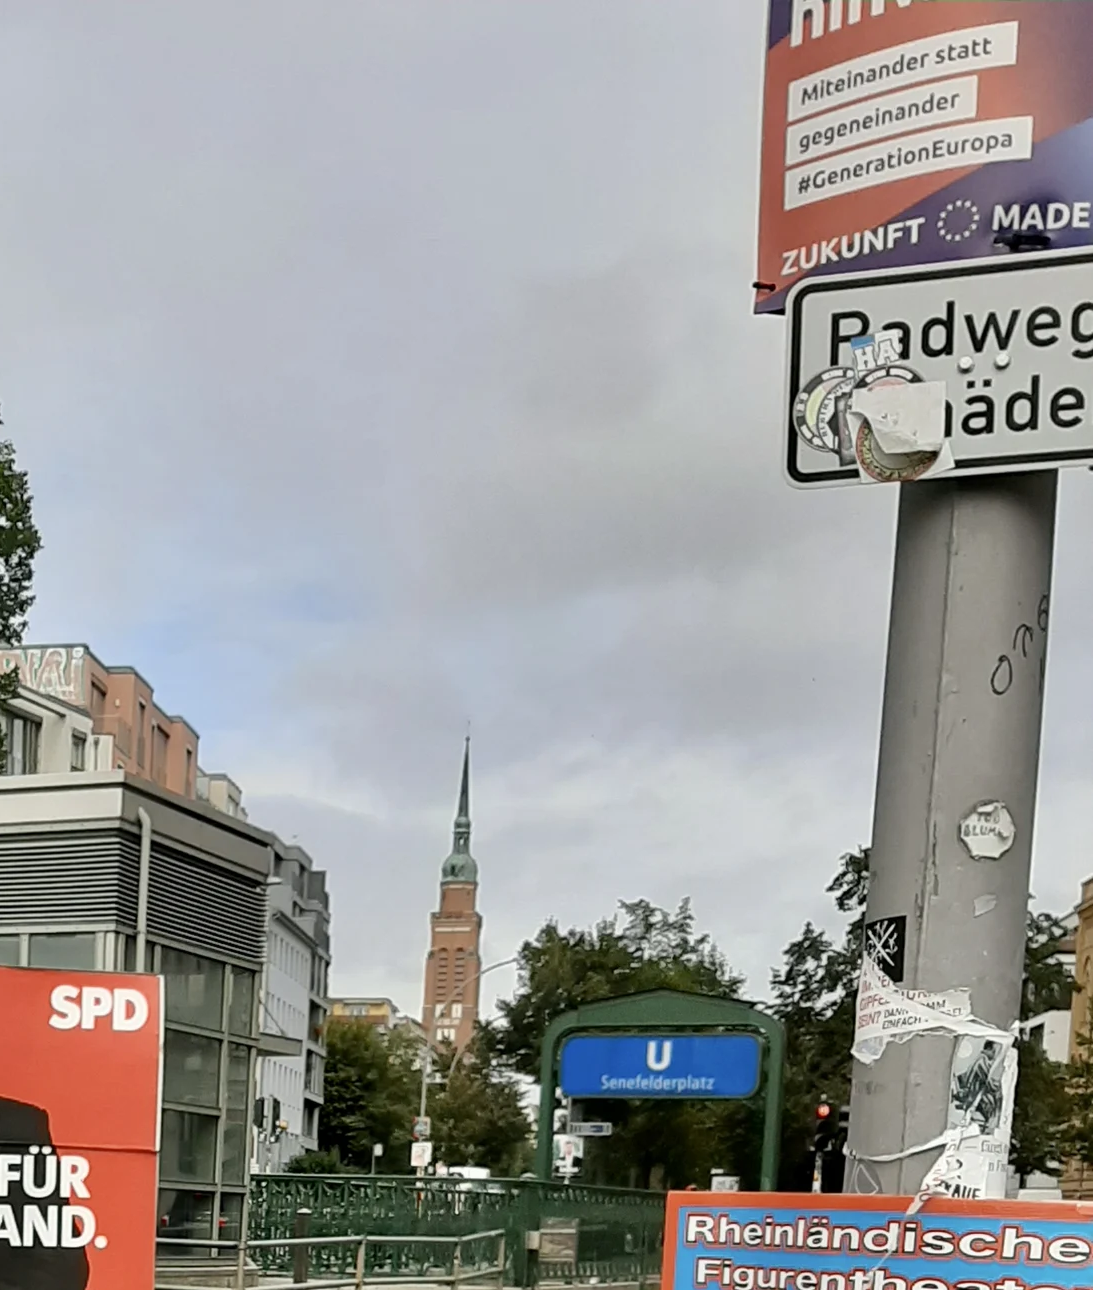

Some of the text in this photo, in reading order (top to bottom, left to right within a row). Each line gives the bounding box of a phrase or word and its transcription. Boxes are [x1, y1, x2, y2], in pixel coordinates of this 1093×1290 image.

[799, 36, 992, 106] Miteinander statt
[799, 91, 960, 153] gegeneinander
[798, 131, 1013, 195] #GenerationEuropa
[780, 202, 1091, 277] ZUKUNFT MADE
[48, 984, 149, 1032] SPD
[600, 1074, 715, 1093] Senefelderplatz
[647, 1040, 672, 1072] U
[685, 1213, 1091, 1264] Rheinländische
